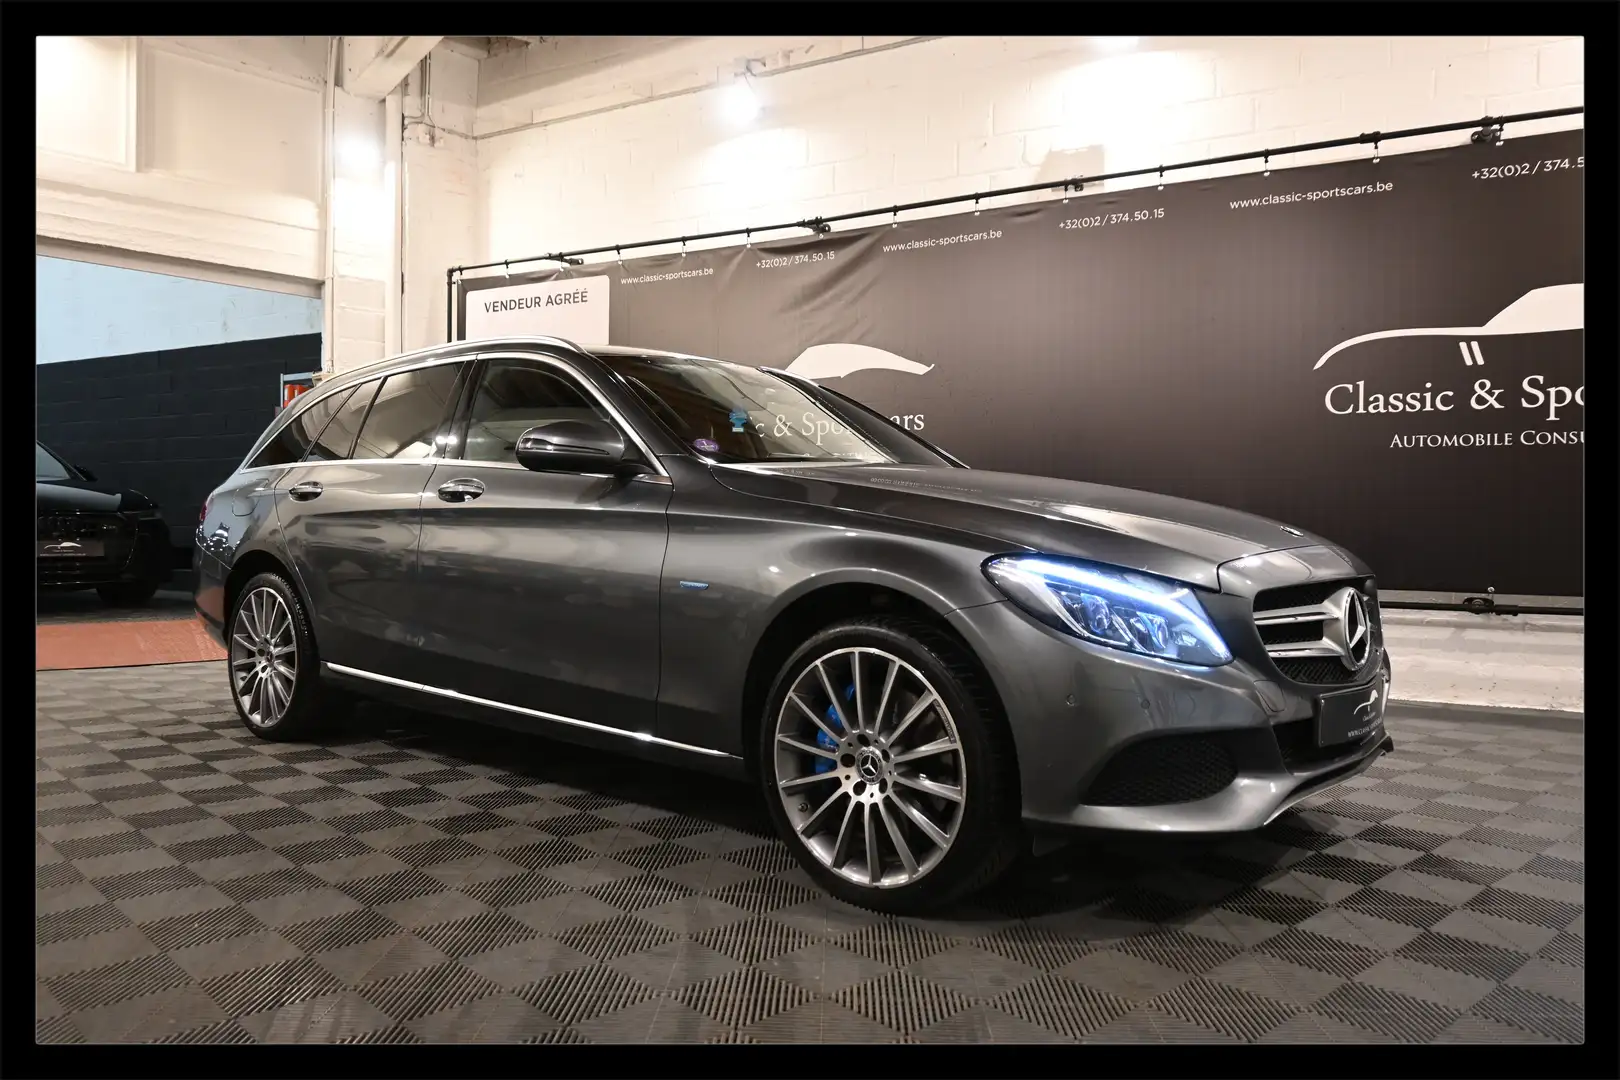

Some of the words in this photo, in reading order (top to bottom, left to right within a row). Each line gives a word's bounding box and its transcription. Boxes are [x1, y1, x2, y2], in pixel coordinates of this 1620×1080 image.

[1229, 181, 1394, 210] www.classic-sportscars.be
[882, 230, 1003, 252] www.classic-sportscars.be
[620, 267, 714, 285] www.classic-sportscars.be
[484, 296, 541, 313] VENDEUR
[545, 288, 588, 307] AGRÉÉ
[1324, 380, 1455, 415] Classic
[1470, 378, 1505, 410] &
[773, 414, 793, 437] &
[1389, 432, 1513, 448] AUTOMOBILE
